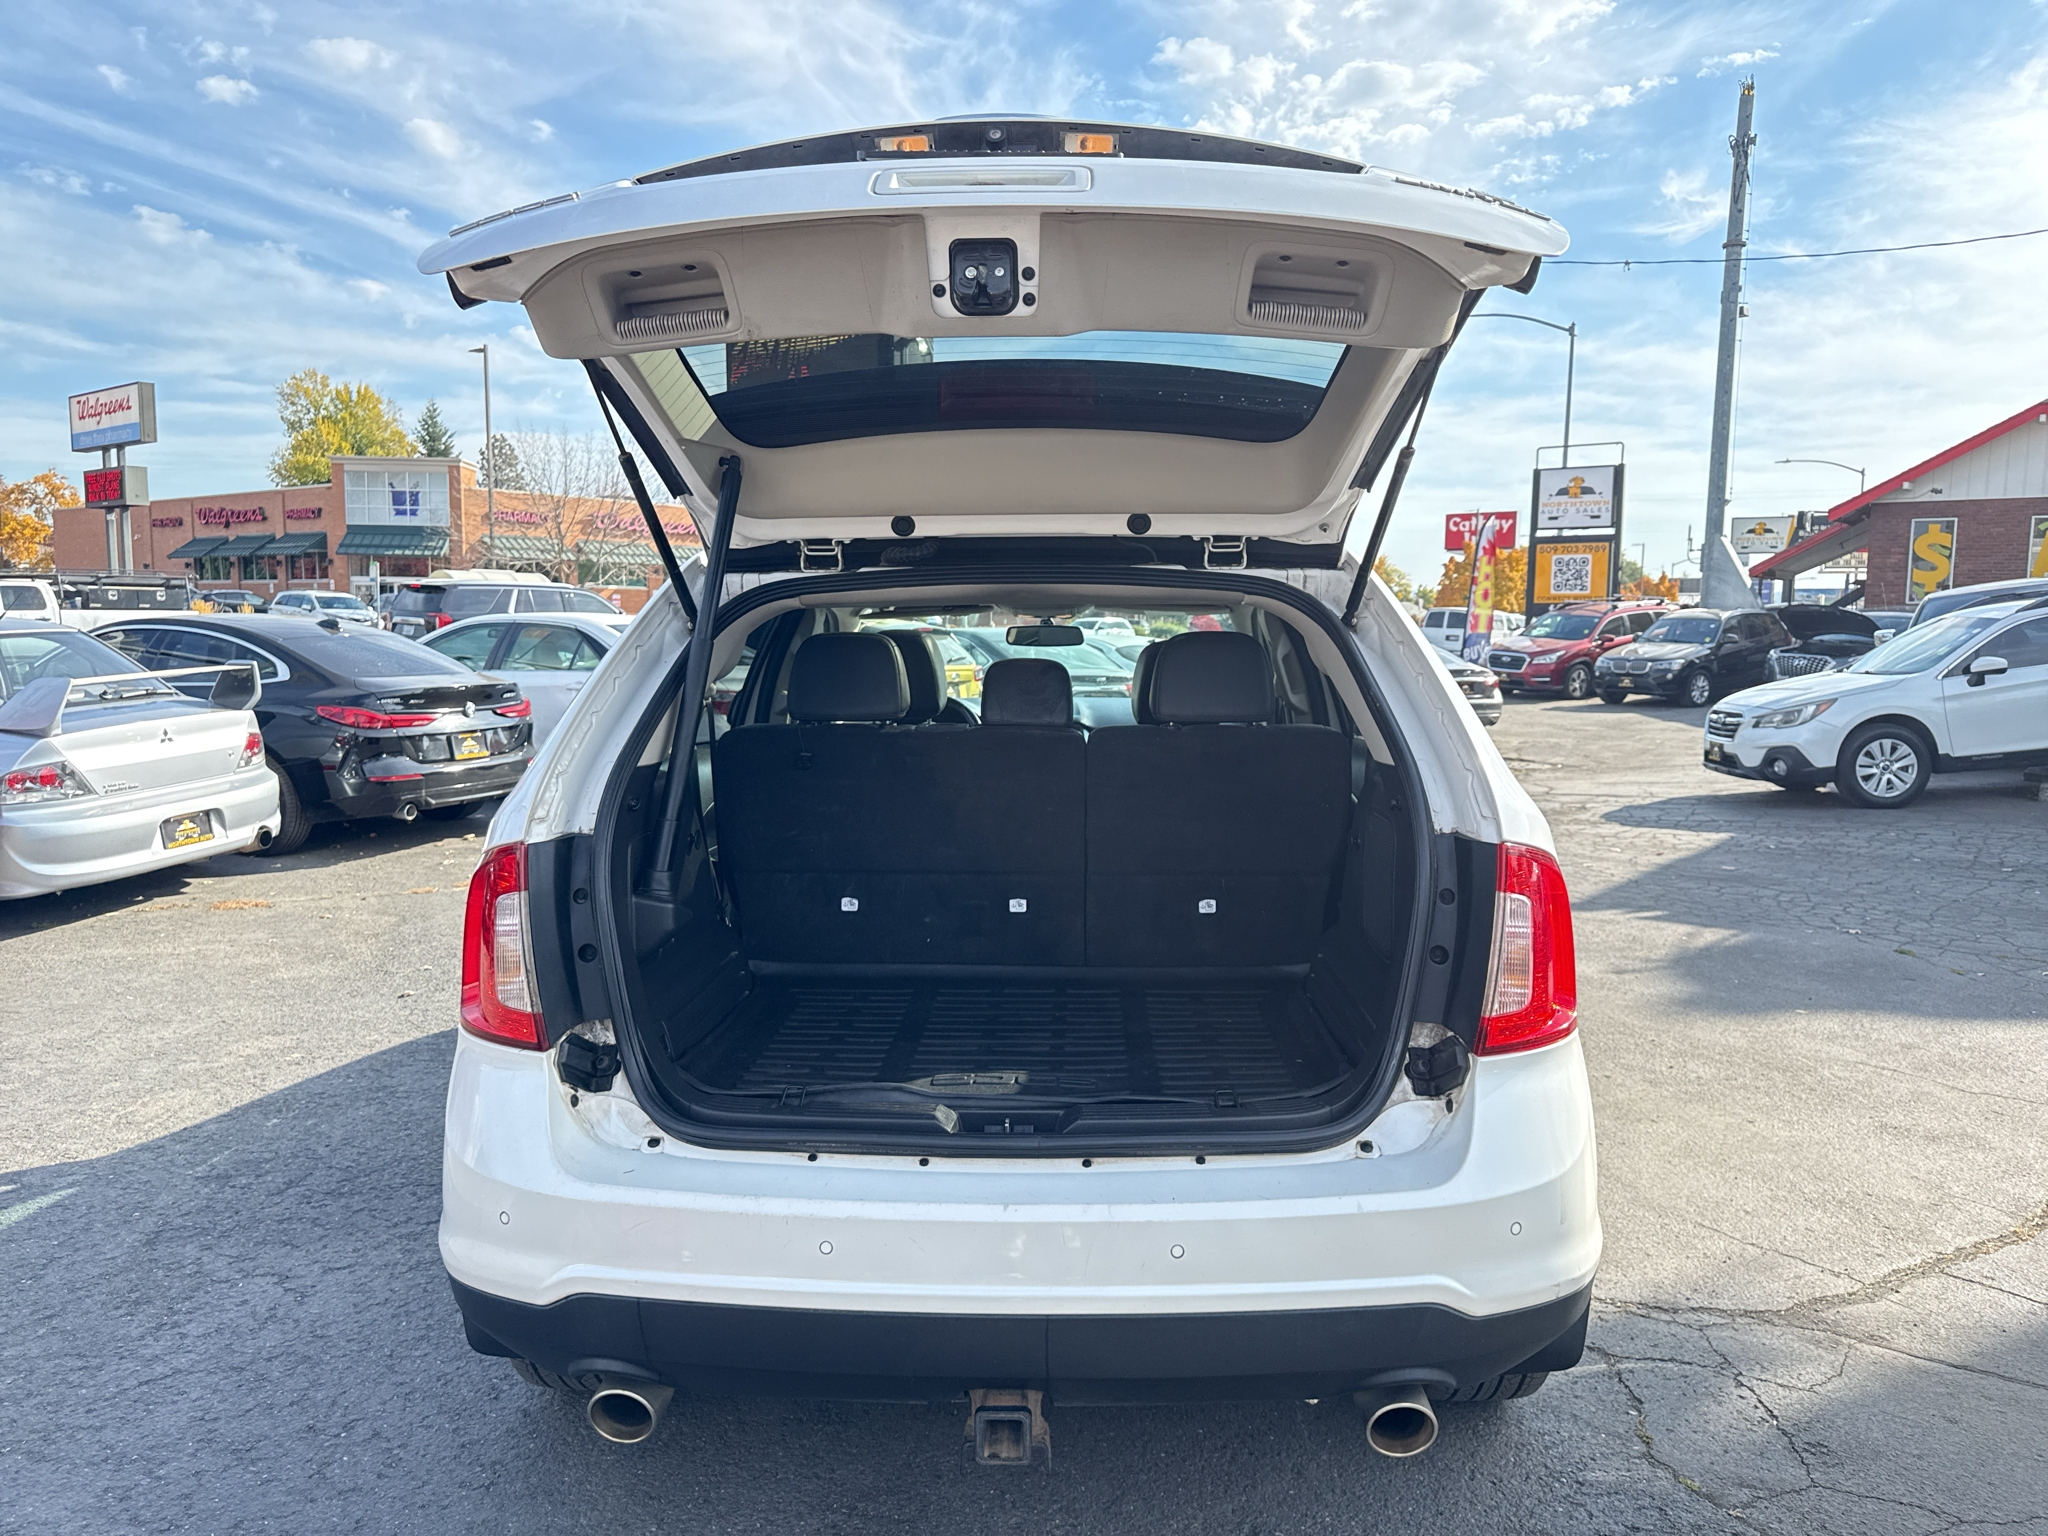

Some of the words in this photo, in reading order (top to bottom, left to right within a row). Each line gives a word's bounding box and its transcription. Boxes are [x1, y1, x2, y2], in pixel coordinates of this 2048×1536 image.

[76, 394, 132, 425] Walgreens
[105, 429, 132, 442] pharmacy
[1541, 500, 1610, 508] NORTHTOWN
[195, 507, 264, 528] Walgreens
[286, 508, 319, 520] PHARMACY
[168, 836, 199, 849] NORTHTOWN
[200, 833, 214, 842] AUTO
